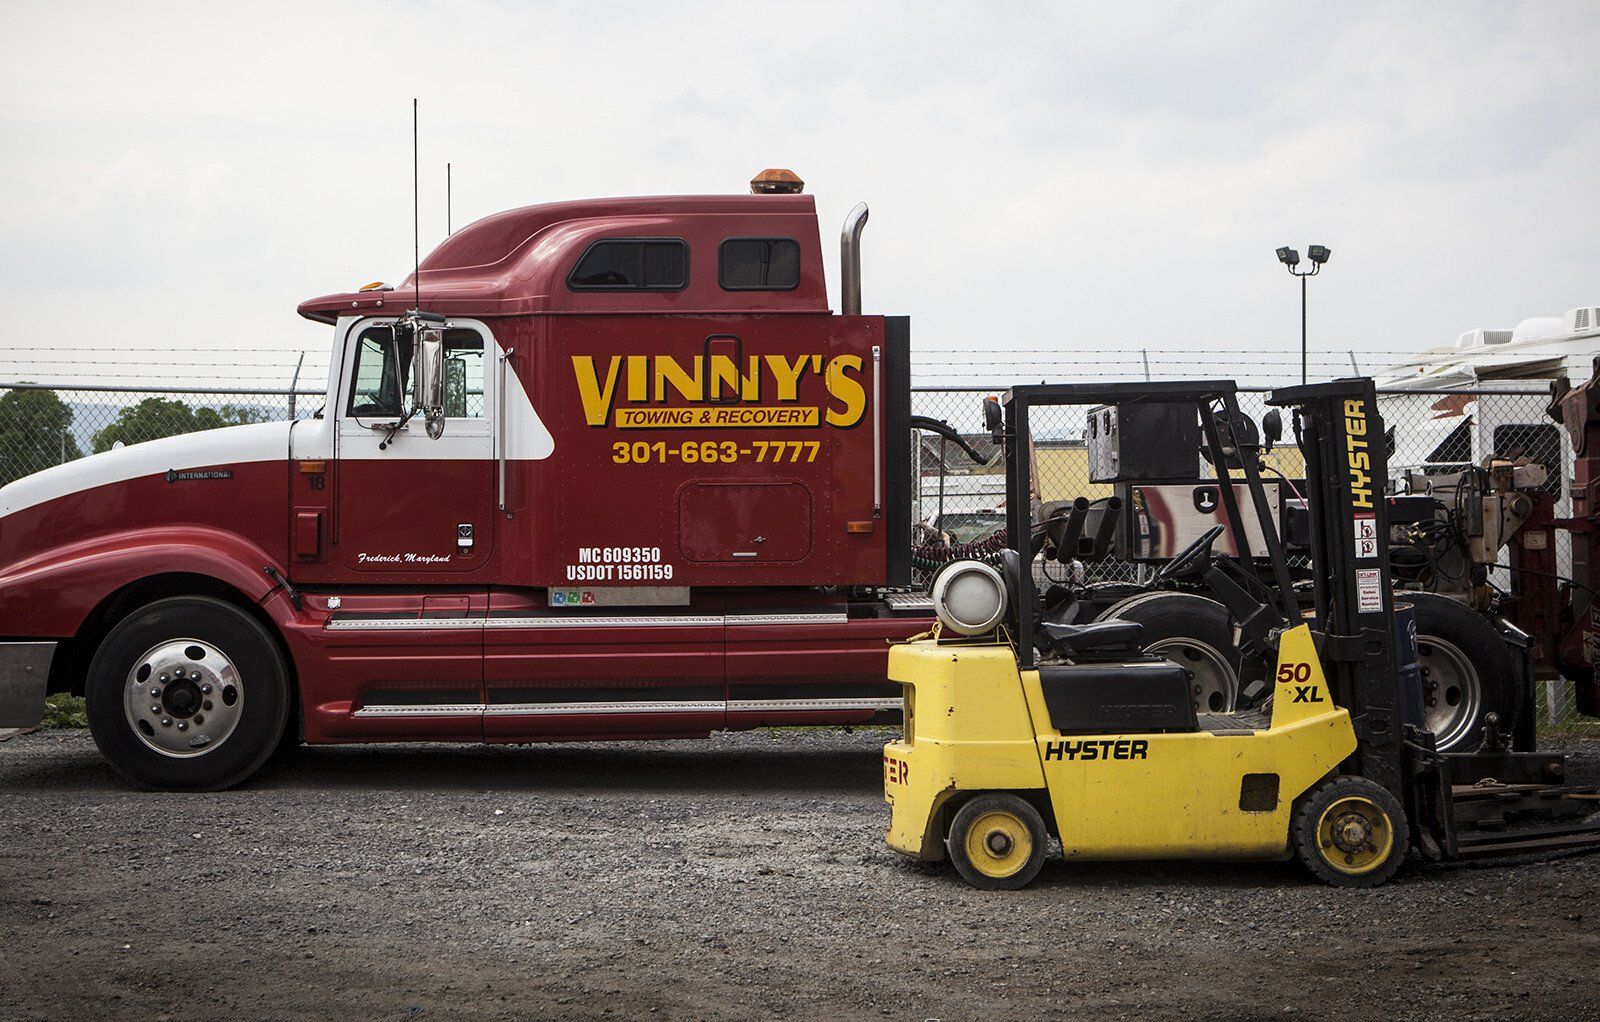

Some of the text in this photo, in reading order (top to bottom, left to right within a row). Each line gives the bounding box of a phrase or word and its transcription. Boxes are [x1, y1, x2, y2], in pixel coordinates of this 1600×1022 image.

[571, 354, 867, 428] VINNY'S
[624, 409, 813, 424] TOWING & RECOVERY
[612, 441, 821, 464] 301-663-7777
[1344, 399, 1374, 509] HYSTER
[178, 471, 232, 479] INTERNATIONAL
[308, 475, 326, 491] 18
[358, 553, 451, 565] Frederick, Maryland
[579, 547, 661, 563] MC 609350
[567, 564, 673, 580] USDOT 1561159
[1277, 663, 1311, 683] 50
[1292, 686, 1323, 703] XL
[1045, 740, 1149, 761] HYSTER
